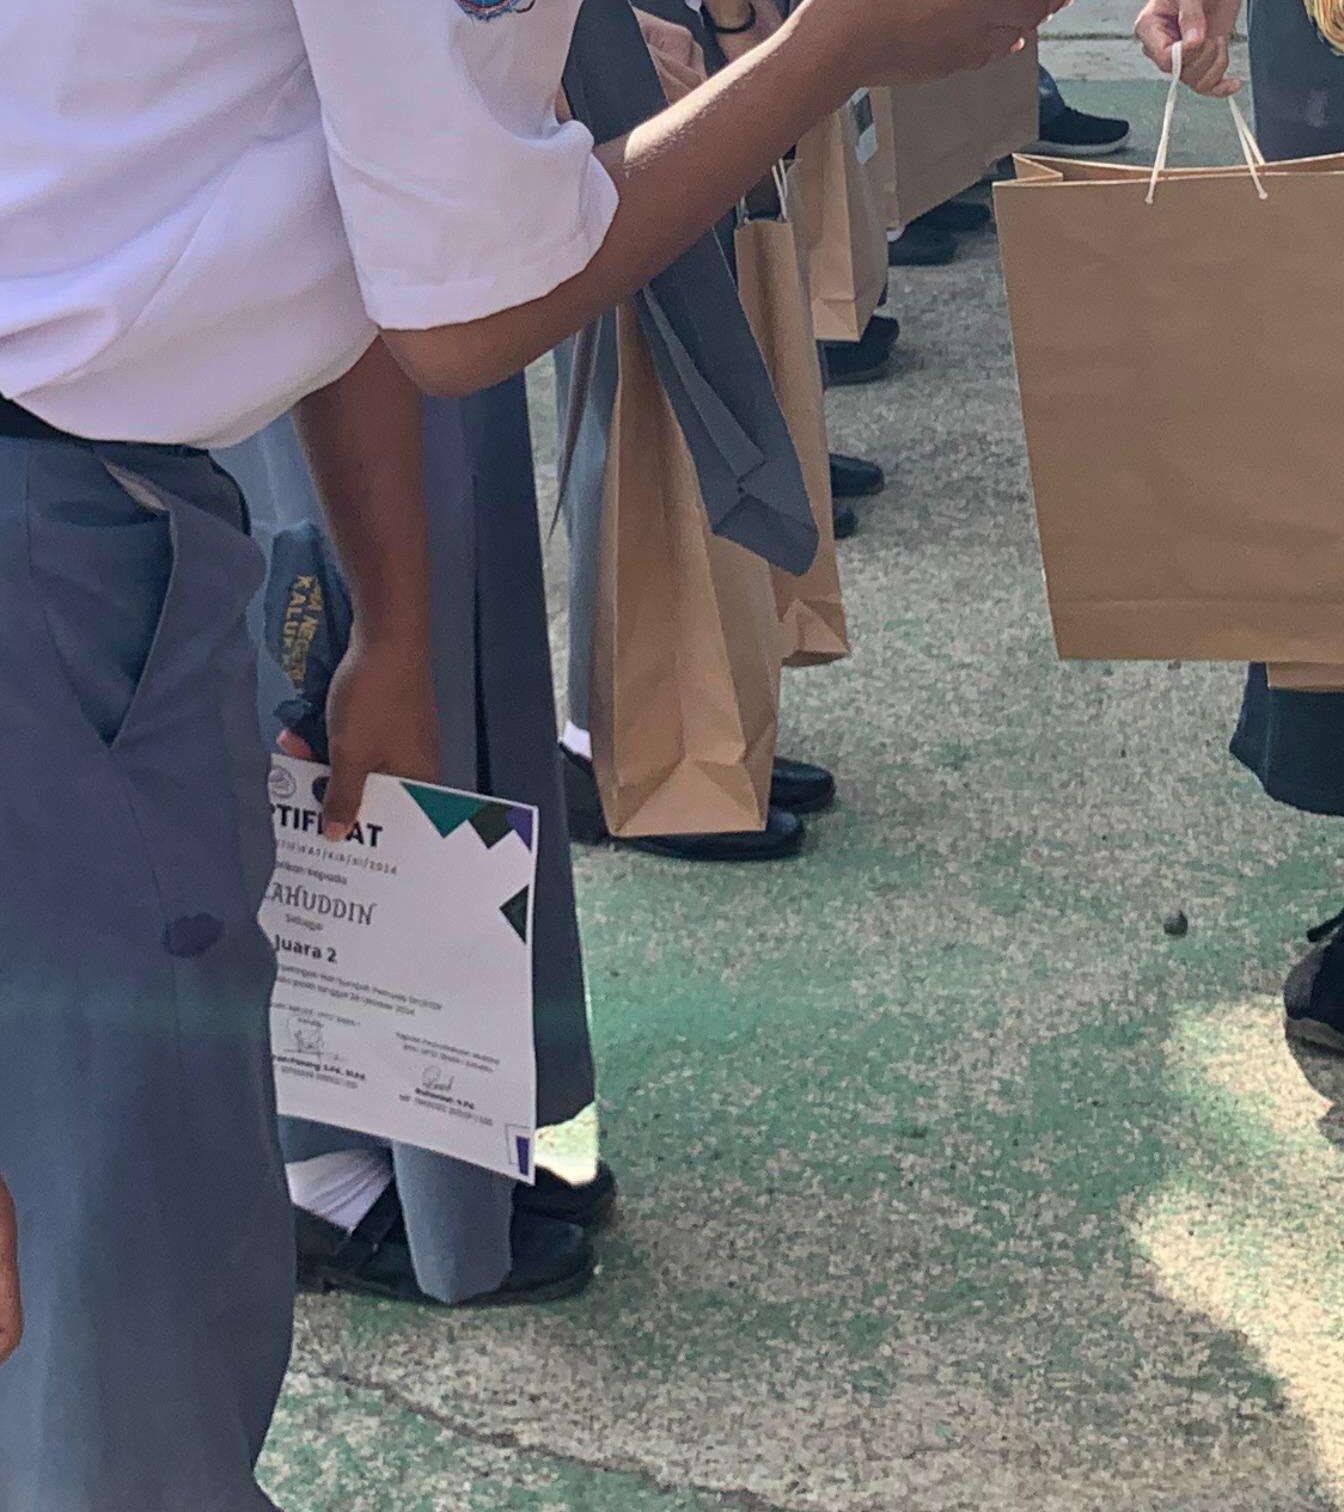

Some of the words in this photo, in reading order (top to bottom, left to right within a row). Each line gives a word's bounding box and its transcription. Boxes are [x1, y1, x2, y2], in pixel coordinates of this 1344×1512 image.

[271, 803, 383, 848] TIFIAT
[275, 934, 322, 960] Juara
[326, 947, 338, 964] 2
